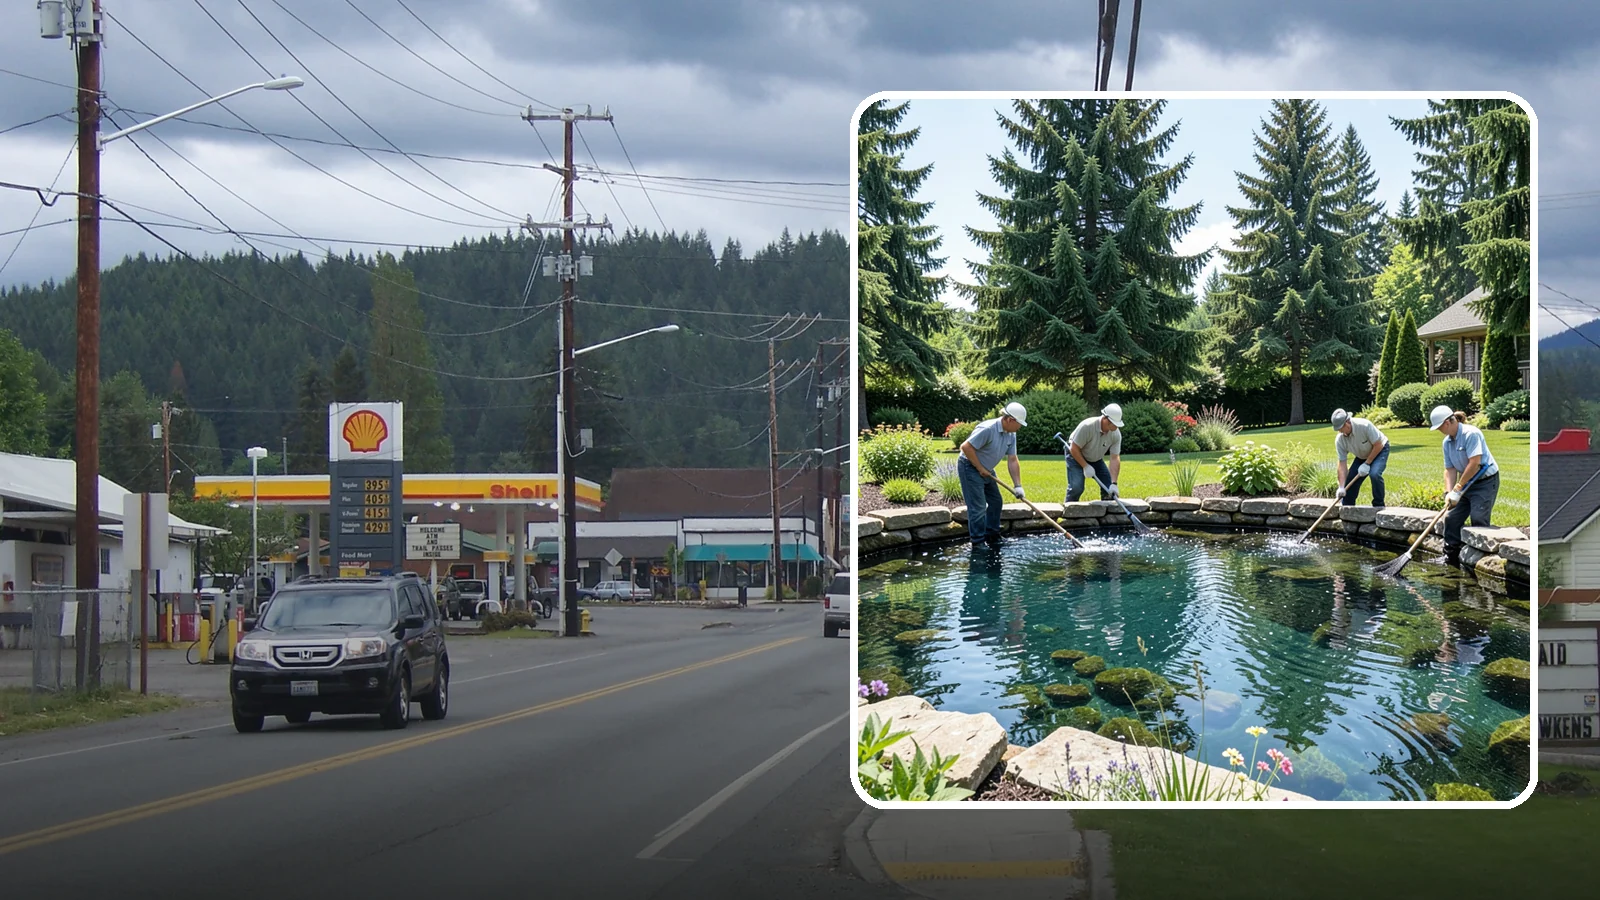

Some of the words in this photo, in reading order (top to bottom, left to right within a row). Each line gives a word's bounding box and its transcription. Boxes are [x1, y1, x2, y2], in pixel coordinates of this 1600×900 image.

[366, 480, 384, 490] 395
[490, 484, 547, 499] Shell
[366, 494, 384, 504] 405
[366, 508, 384, 518] 415
[366, 522, 384, 532] 429
[1538, 643, 1566, 665] AID
